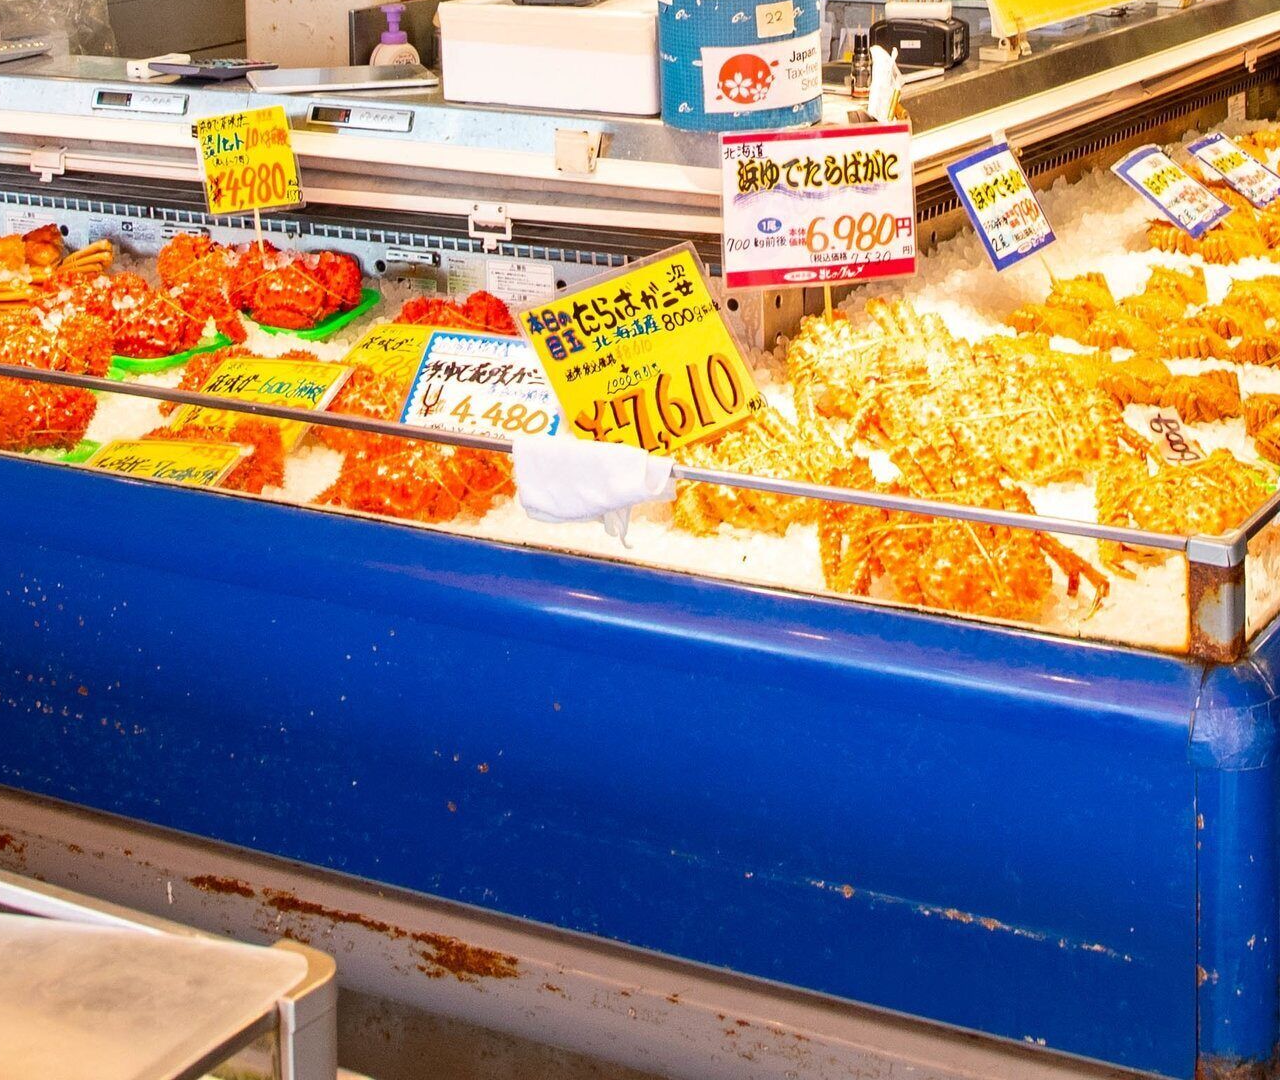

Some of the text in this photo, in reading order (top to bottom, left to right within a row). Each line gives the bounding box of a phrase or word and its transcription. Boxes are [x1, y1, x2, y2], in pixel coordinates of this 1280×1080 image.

[765, 10, 784, 25] 22
[724, 141, 768, 160] 北海道
[737, 149, 899, 192] 浜ゆでたらばがに
[726, 238, 750, 252] 700
[526, 308, 573, 335] 本日の
